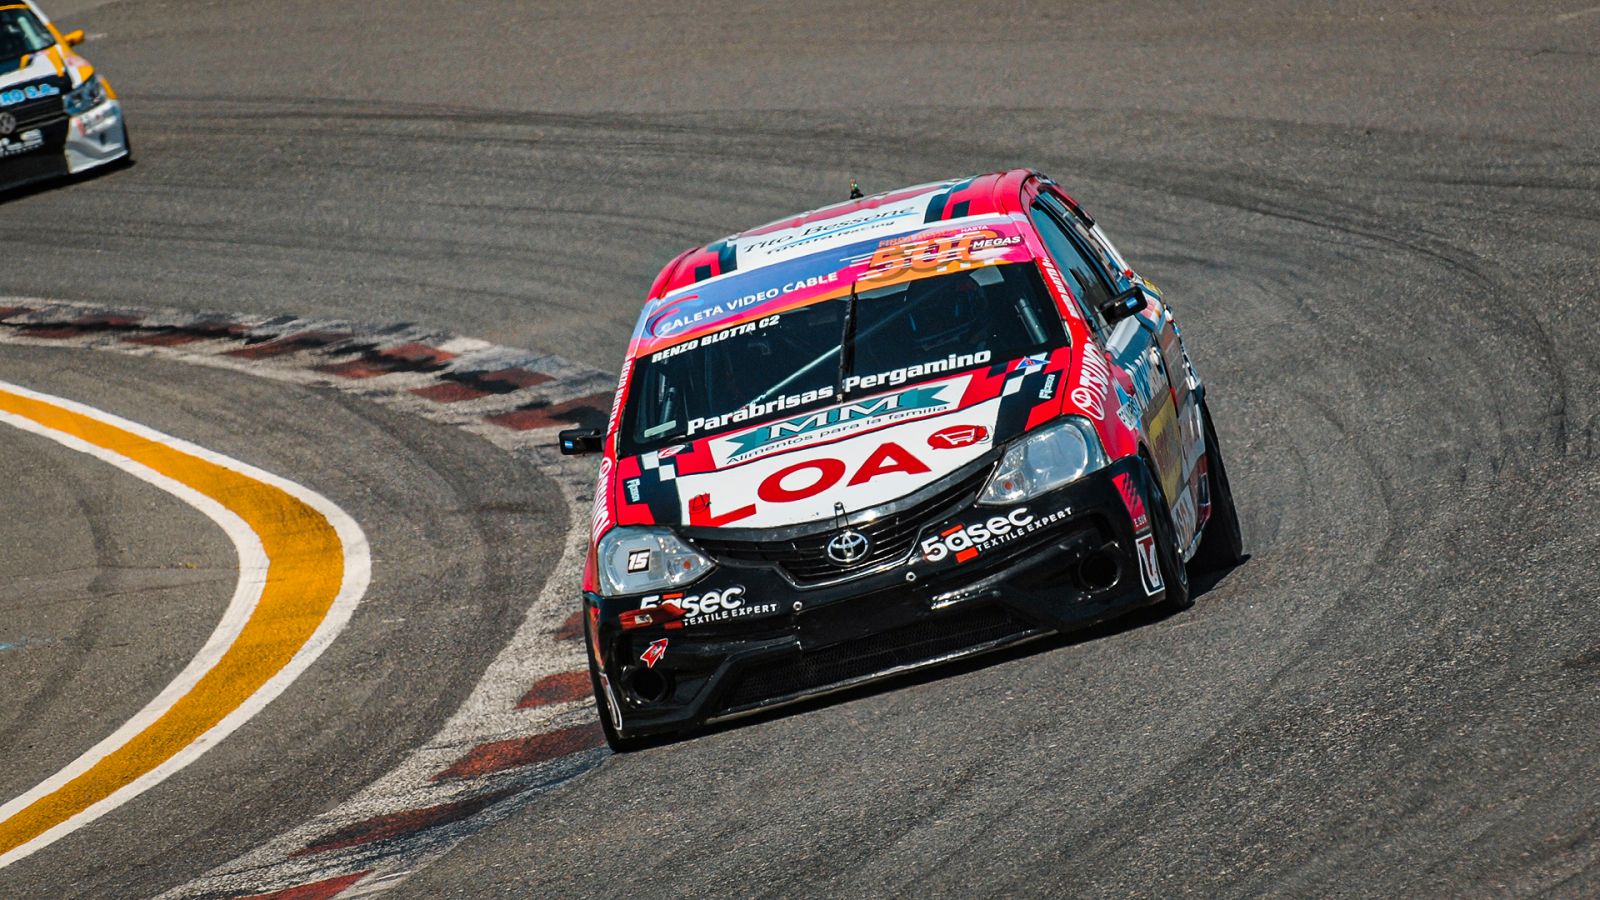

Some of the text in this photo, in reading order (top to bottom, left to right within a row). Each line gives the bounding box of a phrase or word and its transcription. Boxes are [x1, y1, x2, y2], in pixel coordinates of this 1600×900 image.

[744, 206, 915, 254] Tito Bessone
[961, 225, 988, 233] HASTA
[972, 236, 1021, 249] MEGAS
[659, 272, 838, 333] CALETA VIDEO CABLE
[652, 314, 781, 364] RENZO BLOTTA C2
[686, 386, 834, 436] Parabrisas
[842, 350, 992, 393] Pergamino
[767, 392, 902, 439] MM
[726, 404, 948, 465] Alimentos para la familia
[689, 441, 932, 528] LOA
[920, 507, 1034, 562] 5asec
[977, 506, 1072, 552] TEXTILE EXPERT
[628, 552, 650, 570] 15
[683, 603, 777, 626] TEXTILE EXPERT
